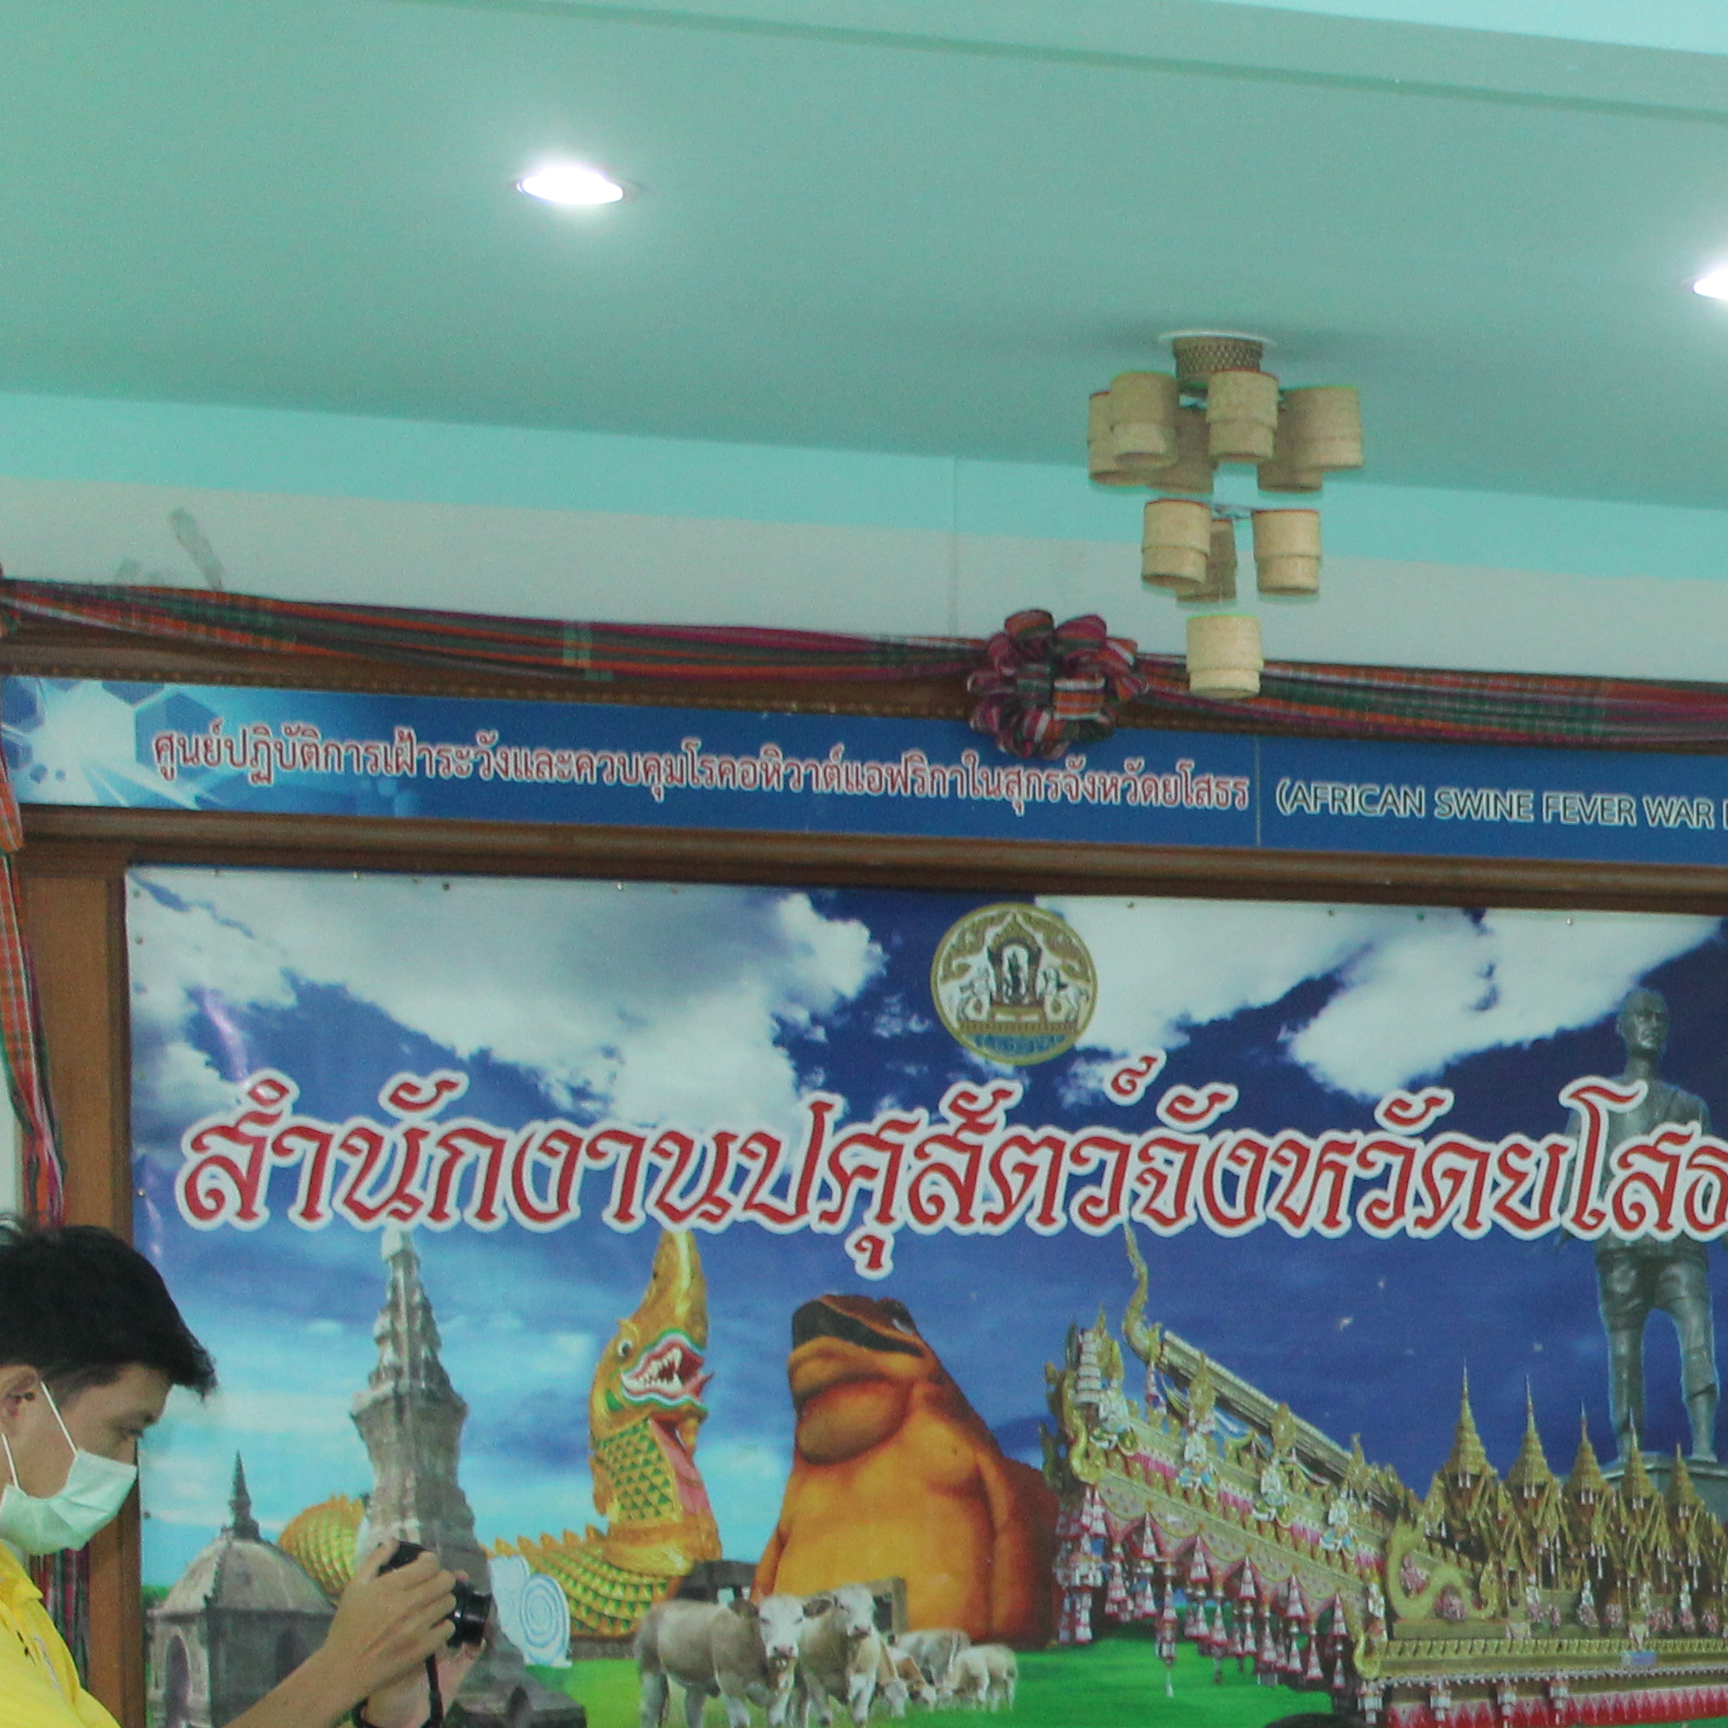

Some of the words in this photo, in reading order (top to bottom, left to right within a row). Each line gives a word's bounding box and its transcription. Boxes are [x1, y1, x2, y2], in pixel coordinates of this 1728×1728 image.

[1276, 777, 1425, 818] (AFRICAN
[1434, 786, 1535, 822] SWINE
[1542, 790, 1638, 827] FEVER
[1643, 795, 1716, 830] WAR
